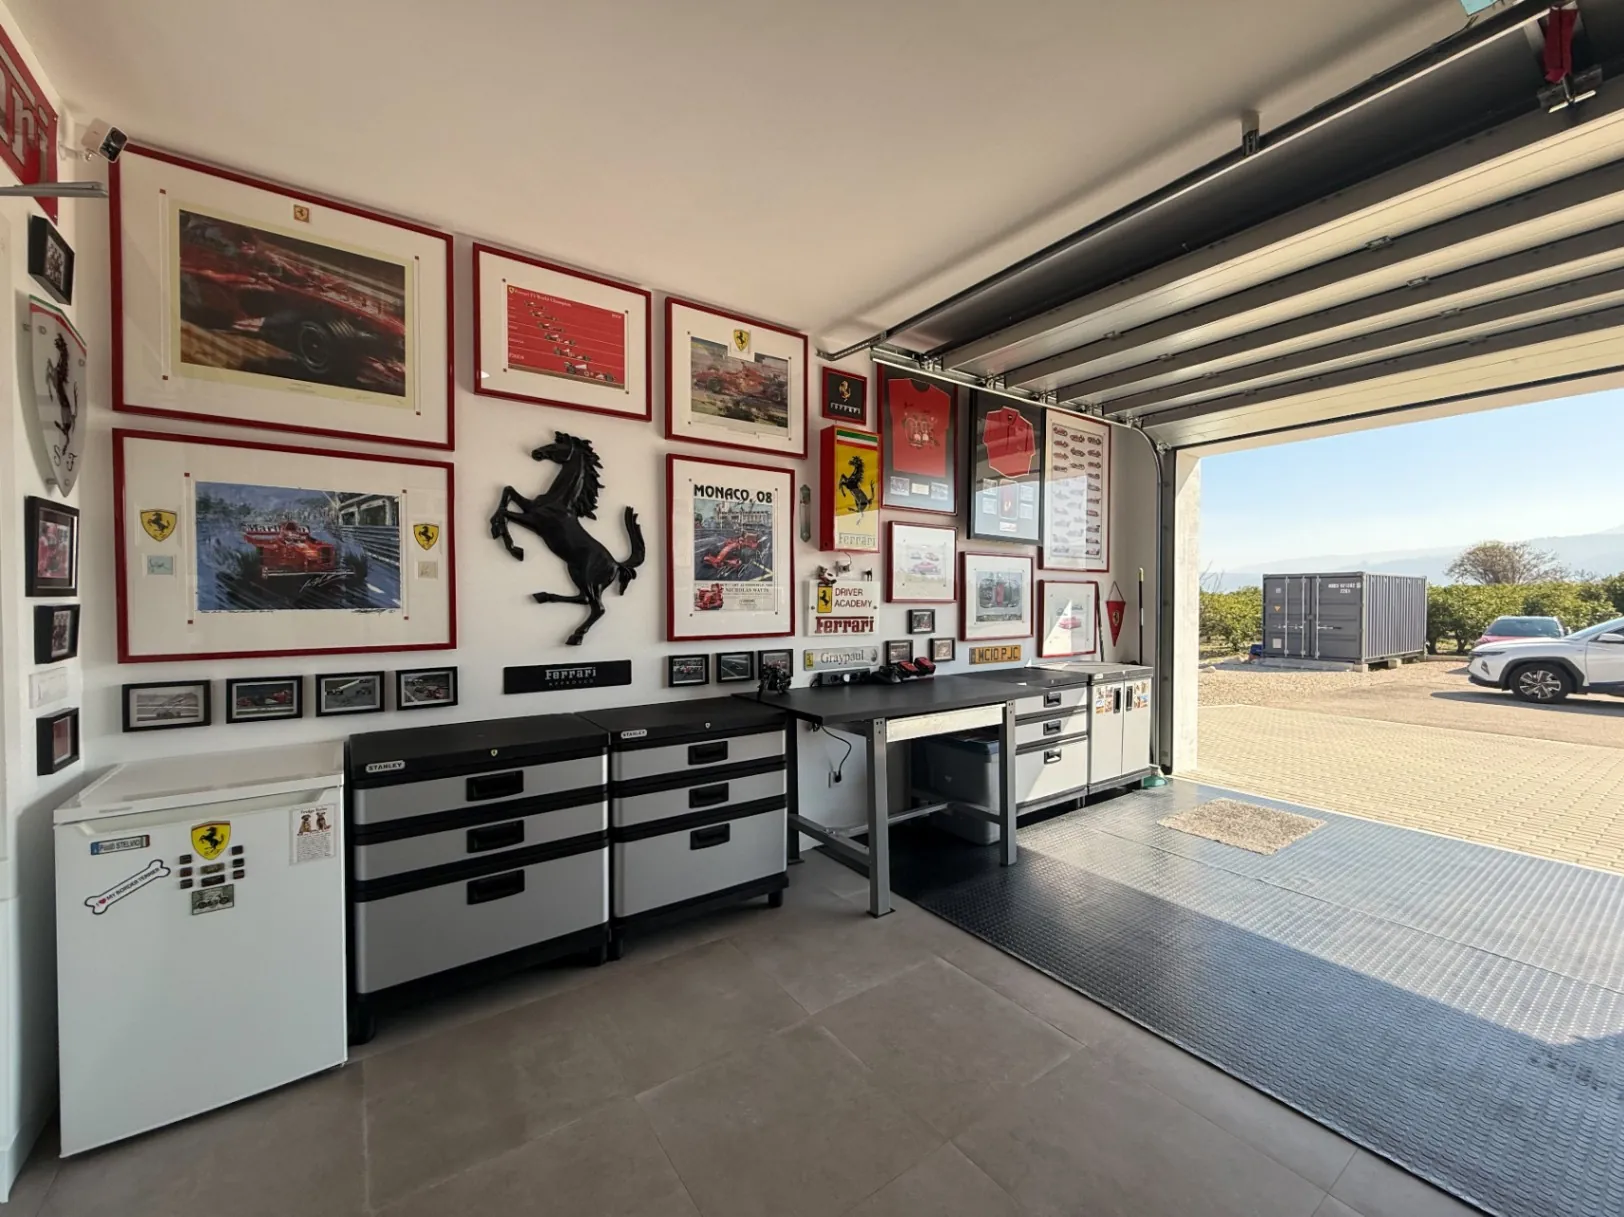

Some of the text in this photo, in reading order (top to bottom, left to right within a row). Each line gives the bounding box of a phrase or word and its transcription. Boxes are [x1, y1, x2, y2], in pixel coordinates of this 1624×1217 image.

[756, 490, 773, 503] 08
[838, 532, 876, 547] Ferrari
[834, 587, 863, 597] DRIVER
[834, 599, 873, 608] ACADEMY
[814, 616, 875, 635] Ferrari
[820, 649, 865, 665] Graypaul
[544, 666, 597, 681] Ferrari
[368, 762, 403, 772] STANLEY
